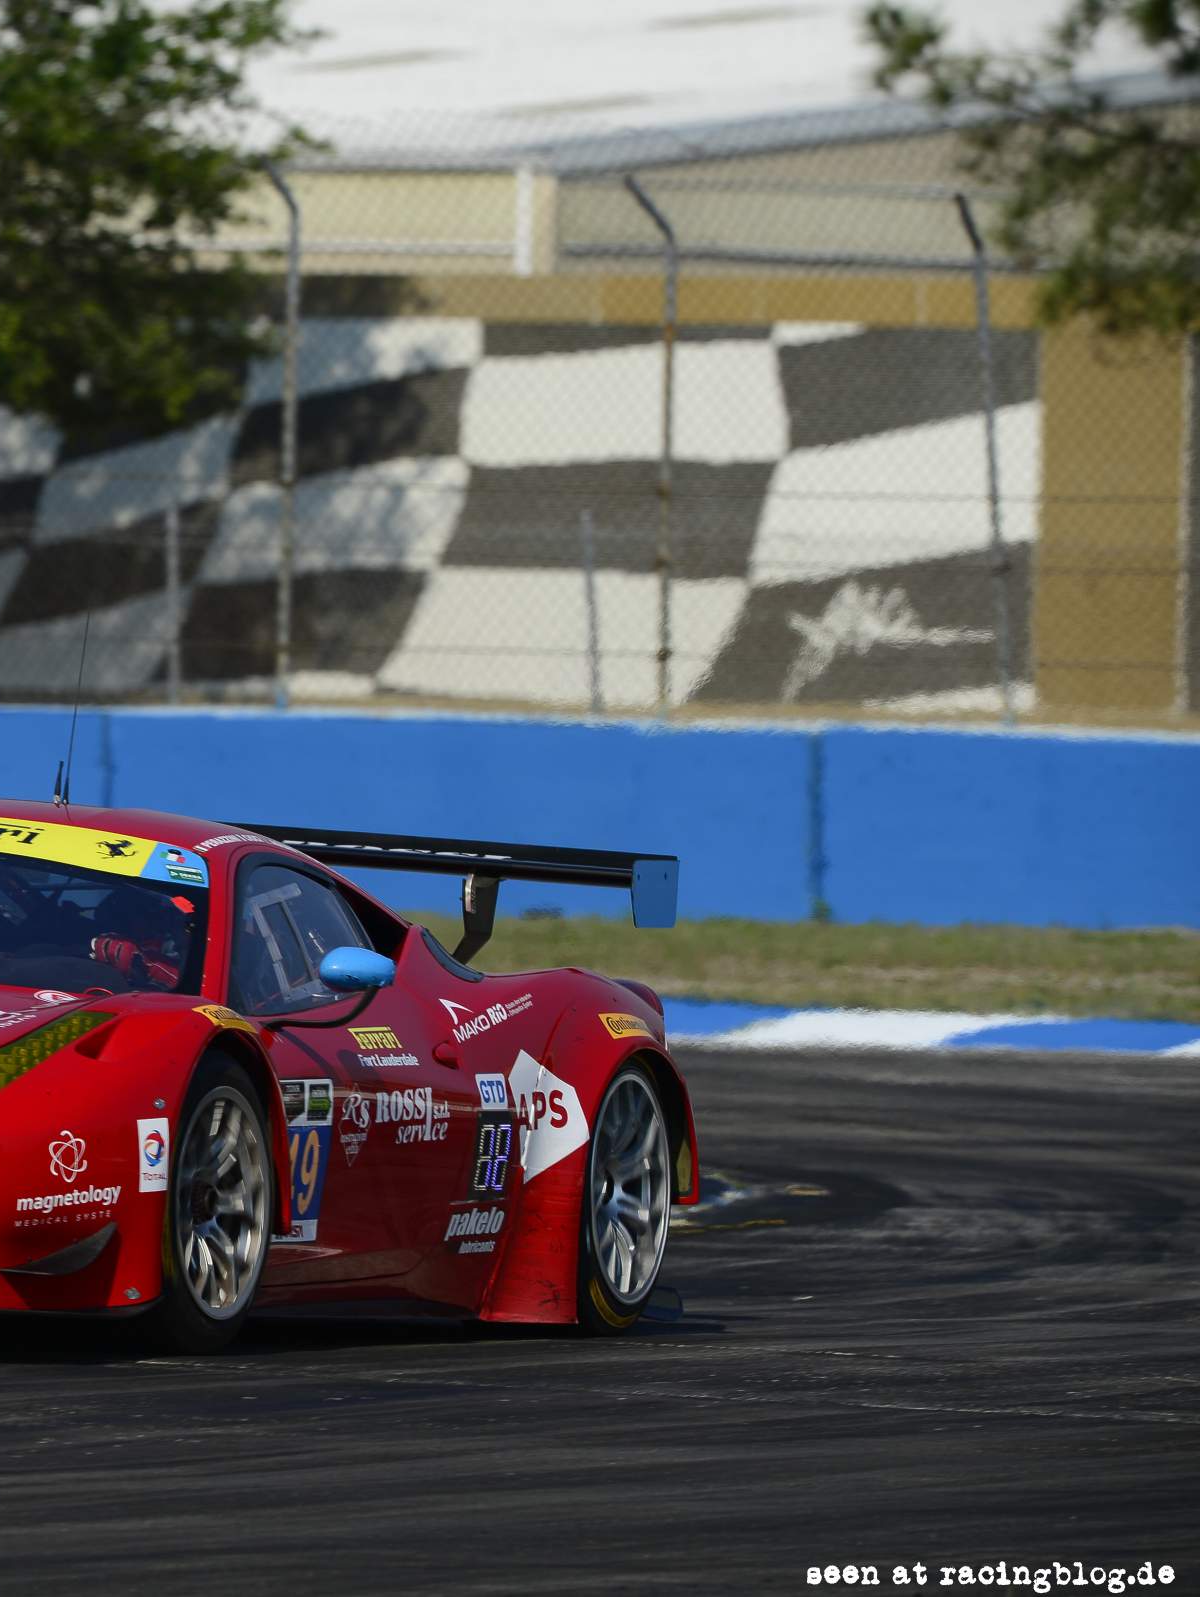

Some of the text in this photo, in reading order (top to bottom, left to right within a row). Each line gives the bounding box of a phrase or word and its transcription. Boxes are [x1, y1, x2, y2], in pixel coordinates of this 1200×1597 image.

[347, 1026, 404, 1050] Ferrari
[452, 1014, 491, 1044] MAKO
[480, 1080, 506, 1104] GTD
[375, 1087, 432, 1140] ROSSI
[519, 1089, 569, 1131] APS
[16, 1184, 122, 1214] magnetology
[14, 1216, 68, 1228] MEDICAL
[443, 1206, 505, 1242] pakelo
